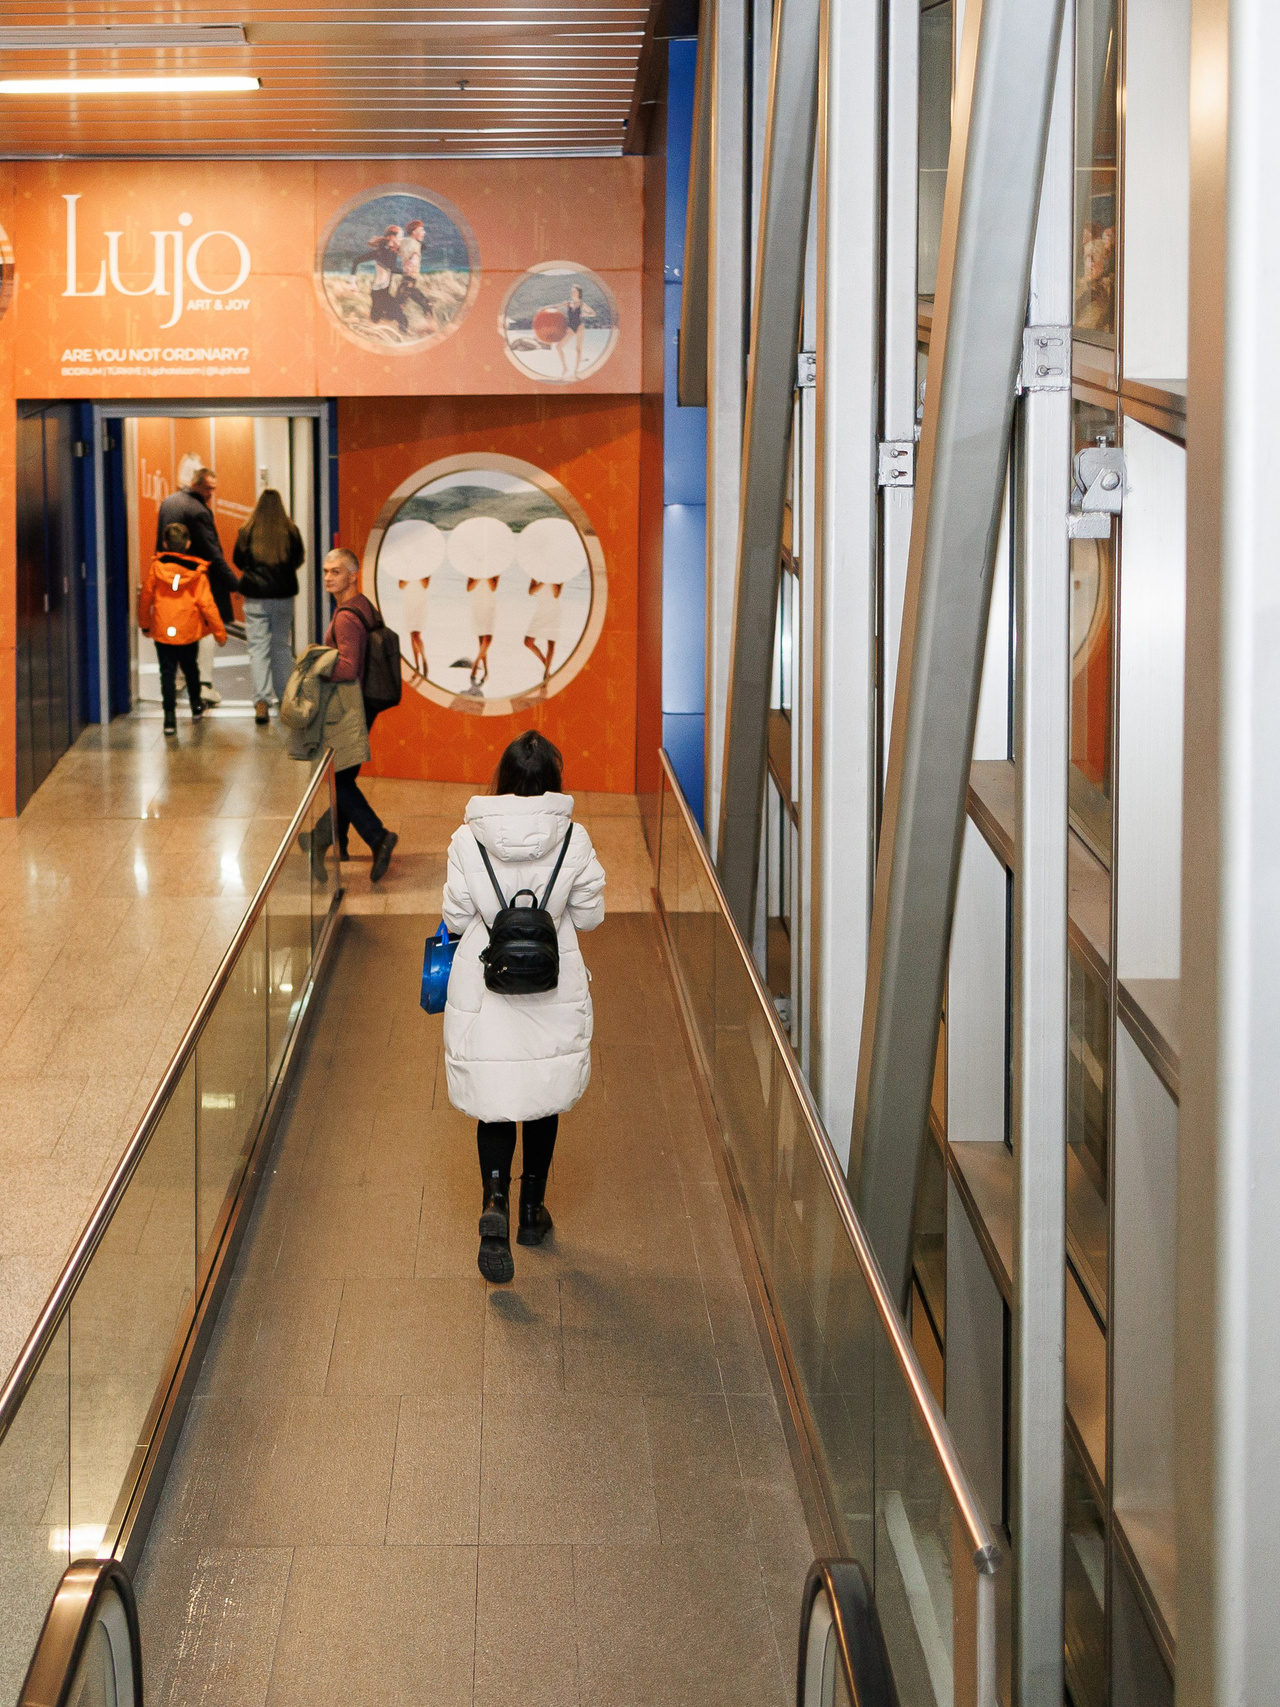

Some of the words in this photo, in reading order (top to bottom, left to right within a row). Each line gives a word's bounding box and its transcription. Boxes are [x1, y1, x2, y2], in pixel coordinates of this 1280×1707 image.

[61, 194, 251, 329] Lujo
[186, 299, 212, 311] ART
[213, 299, 223, 311] &
[225, 299, 251, 311] JOY
[61, 348, 93, 362] ARE
[93, 348, 127, 362] YOU
[128, 348, 161, 362] NOT
[162, 347, 249, 361] ORDINARY?
